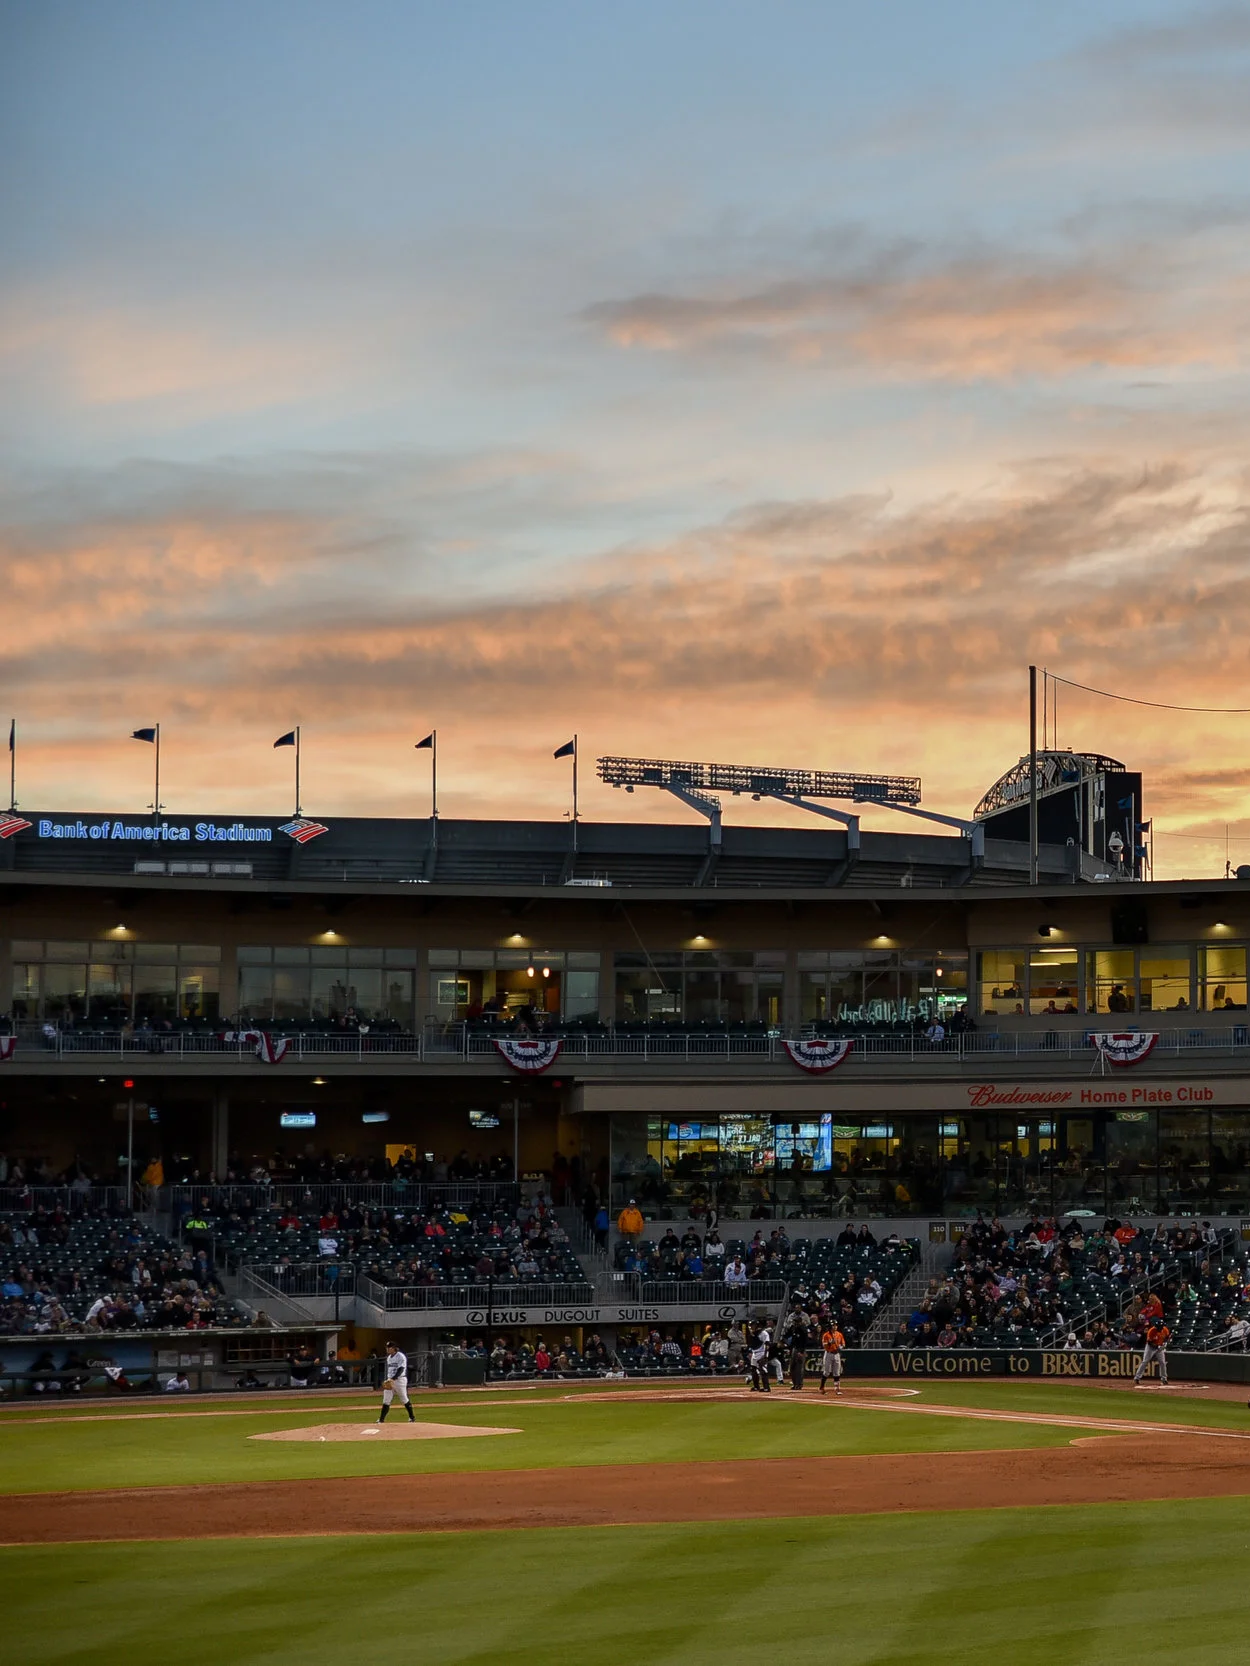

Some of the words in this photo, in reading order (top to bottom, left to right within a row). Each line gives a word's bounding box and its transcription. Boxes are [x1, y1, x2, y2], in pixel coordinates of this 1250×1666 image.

[38, 820, 88, 839] Bank
[90, 820, 111, 839] of
[111, 822, 190, 841] America
[194, 823, 272, 842] Stadium
[967, 1085, 1072, 1107] Budweiser
[1080, 1089, 1127, 1104] Home
[1131, 1088, 1173, 1103] Plate
[1177, 1087, 1214, 1102] Club
[486, 1311, 527, 1324] LEXUS
[544, 1309, 601, 1323] DUGOUT
[618, 1308, 659, 1321] SUITES
[890, 1352, 992, 1373] Welcome
[1009, 1353, 1030, 1373] to
[1041, 1352, 1095, 1376] BB&T
[1098, 1353, 1168, 1377] BallPar
